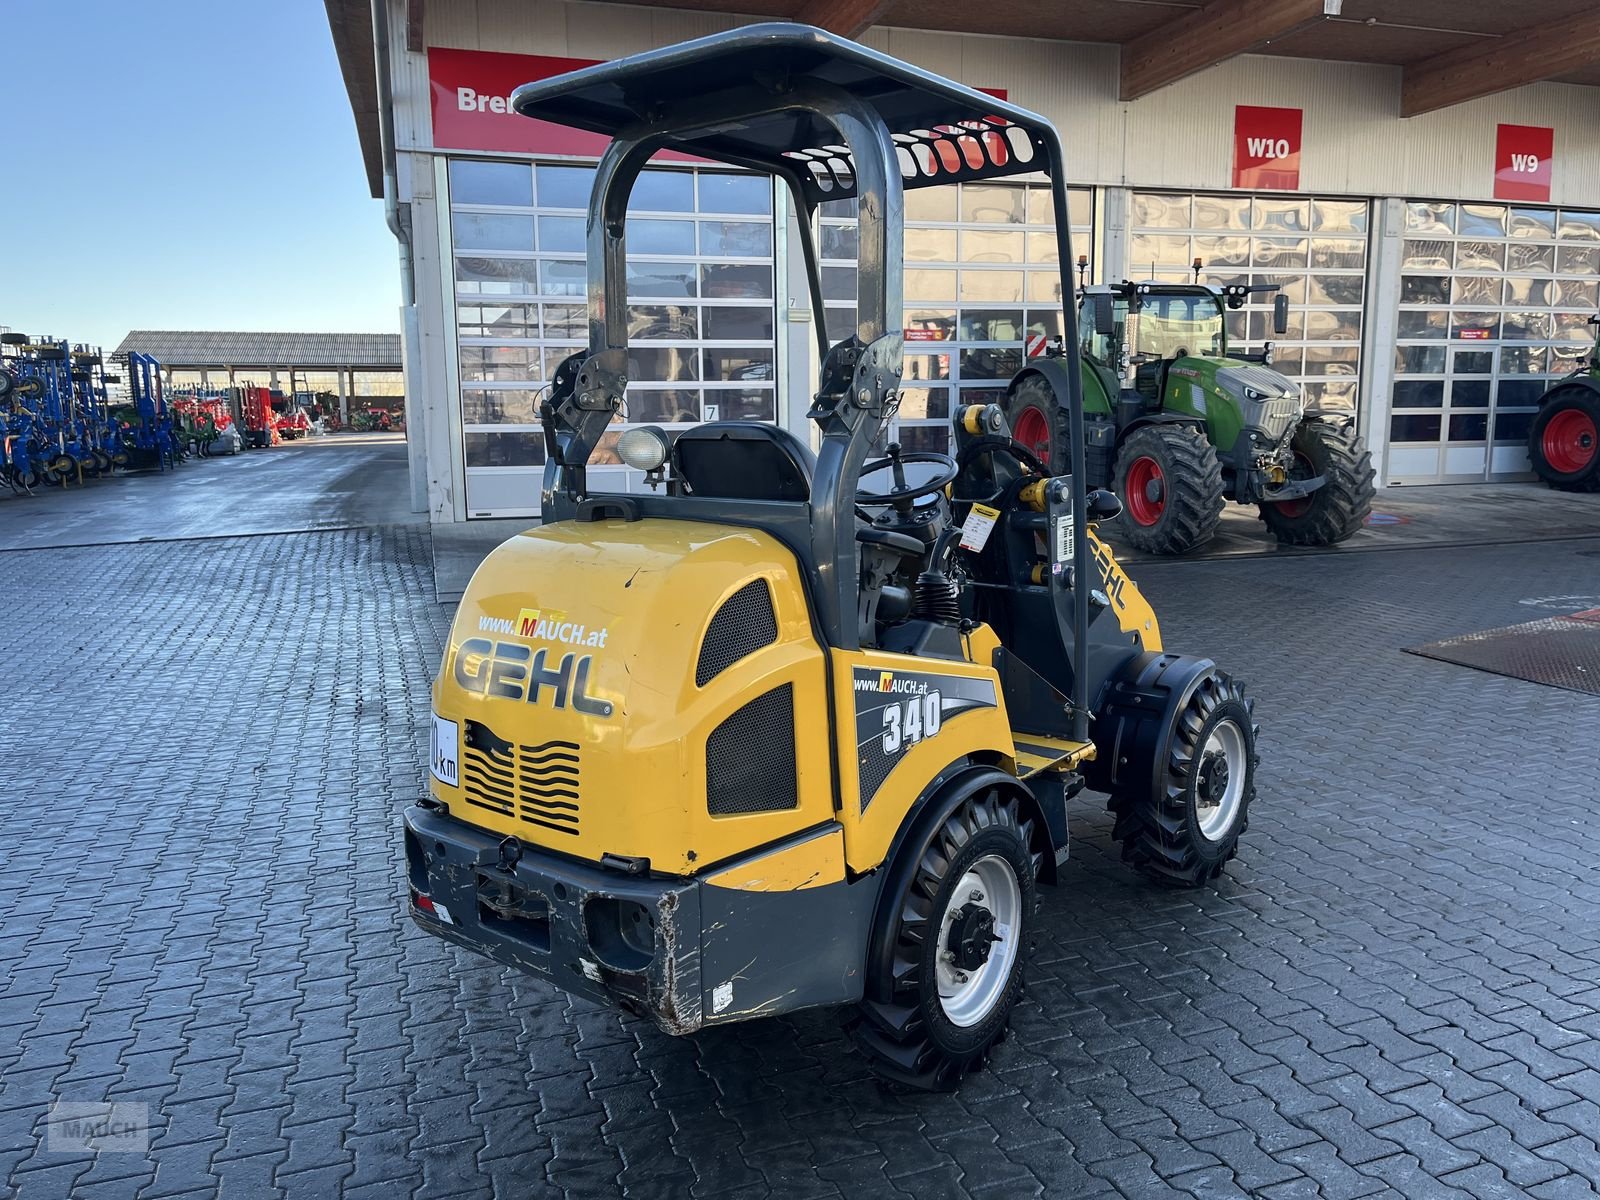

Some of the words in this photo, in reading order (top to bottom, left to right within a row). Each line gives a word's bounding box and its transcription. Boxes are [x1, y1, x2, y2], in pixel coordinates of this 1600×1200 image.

[1247, 137, 1290, 159] W10
[1511, 153, 1539, 173] W9
[789, 297, 796, 307] 7
[706, 406, 716, 420] 7
[478, 615, 608, 649] www.MAUCH.at
[453, 637, 614, 718] GEHL
[854, 678, 928, 695] www.MAUCH.at
[882, 689, 942, 755] 340
[439, 748, 456, 779] km
